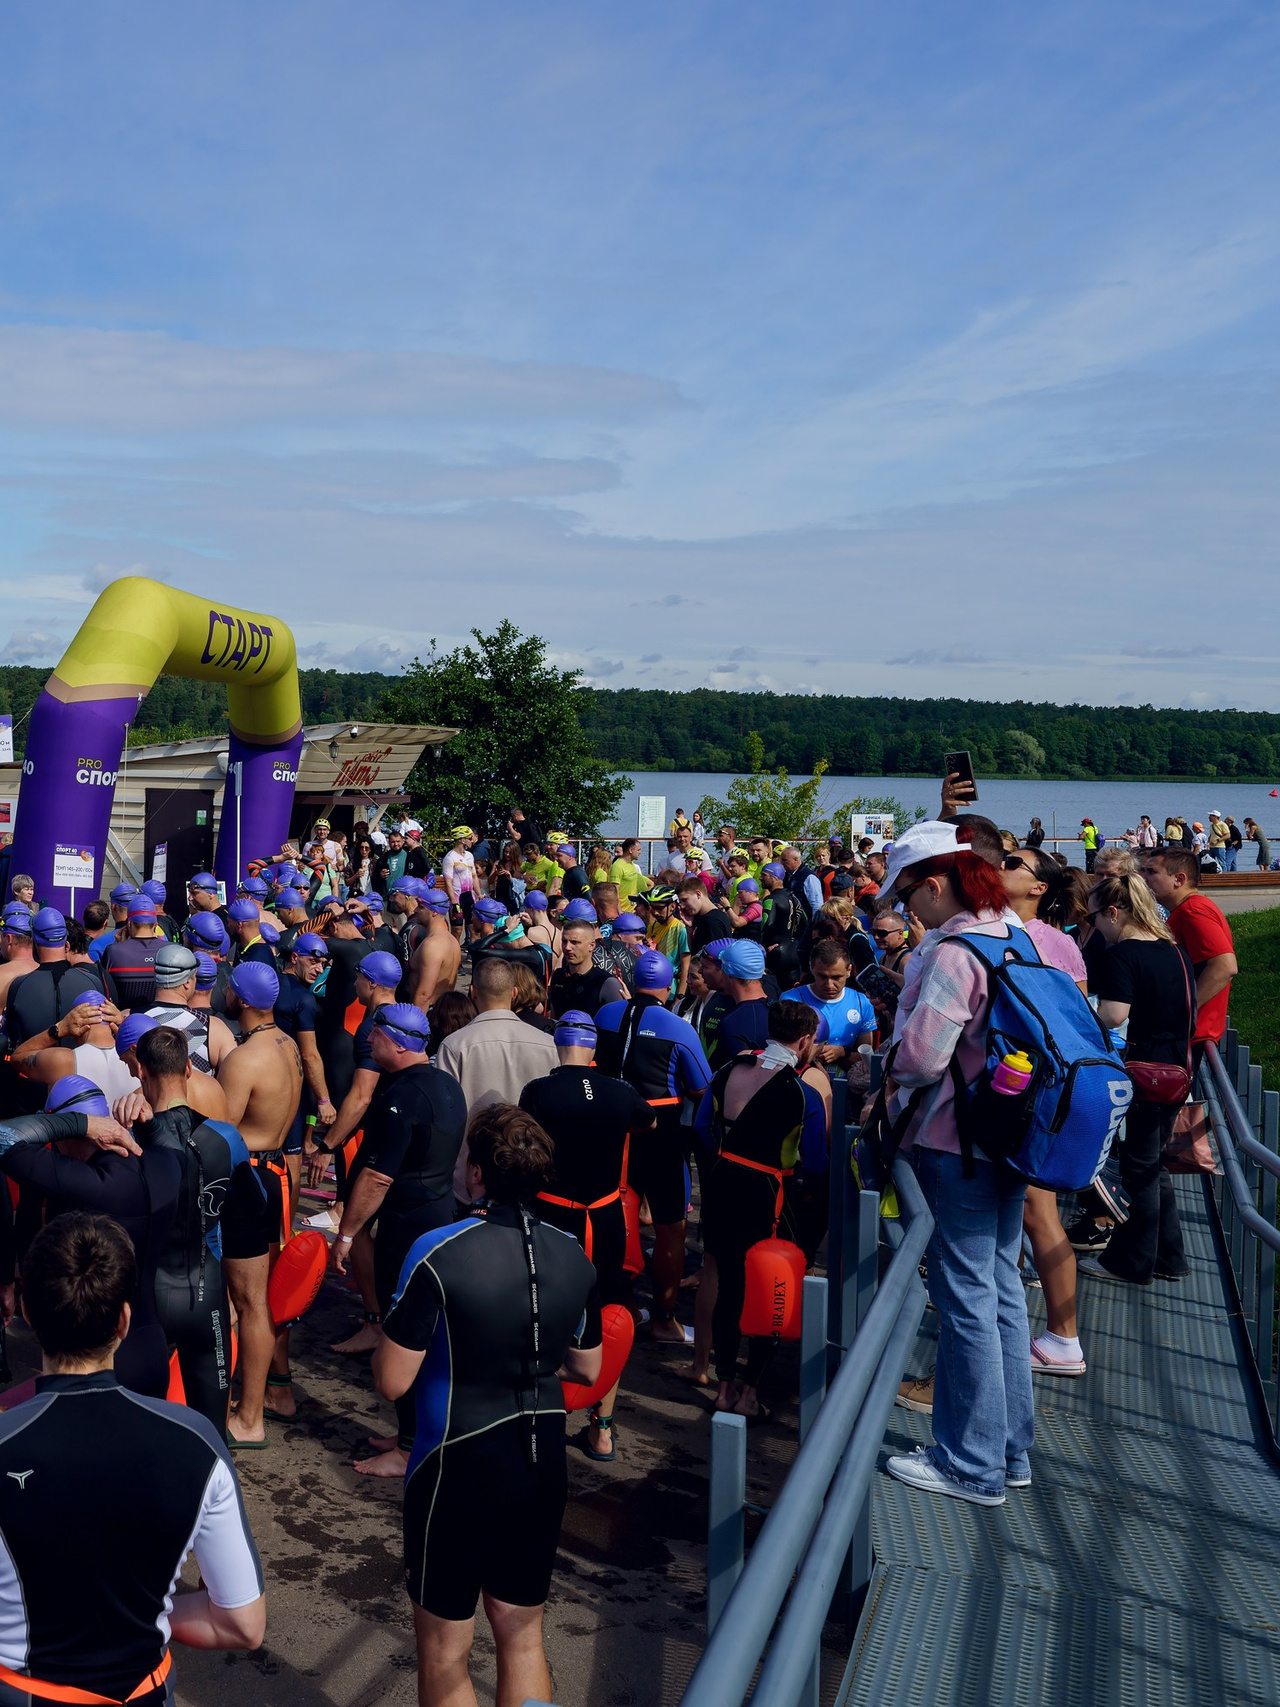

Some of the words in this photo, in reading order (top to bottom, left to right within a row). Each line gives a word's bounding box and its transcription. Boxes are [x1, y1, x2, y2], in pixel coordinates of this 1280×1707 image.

[201, 610, 273, 674] СТАРТ
[23, 759, 34, 776] 40
[77, 757, 103, 770] PRO
[273, 761, 291, 770] PRO
[75, 769, 118, 786] СПОР
[272, 769, 297, 782] СПО
[772, 1281, 786, 1327] BRADEX
